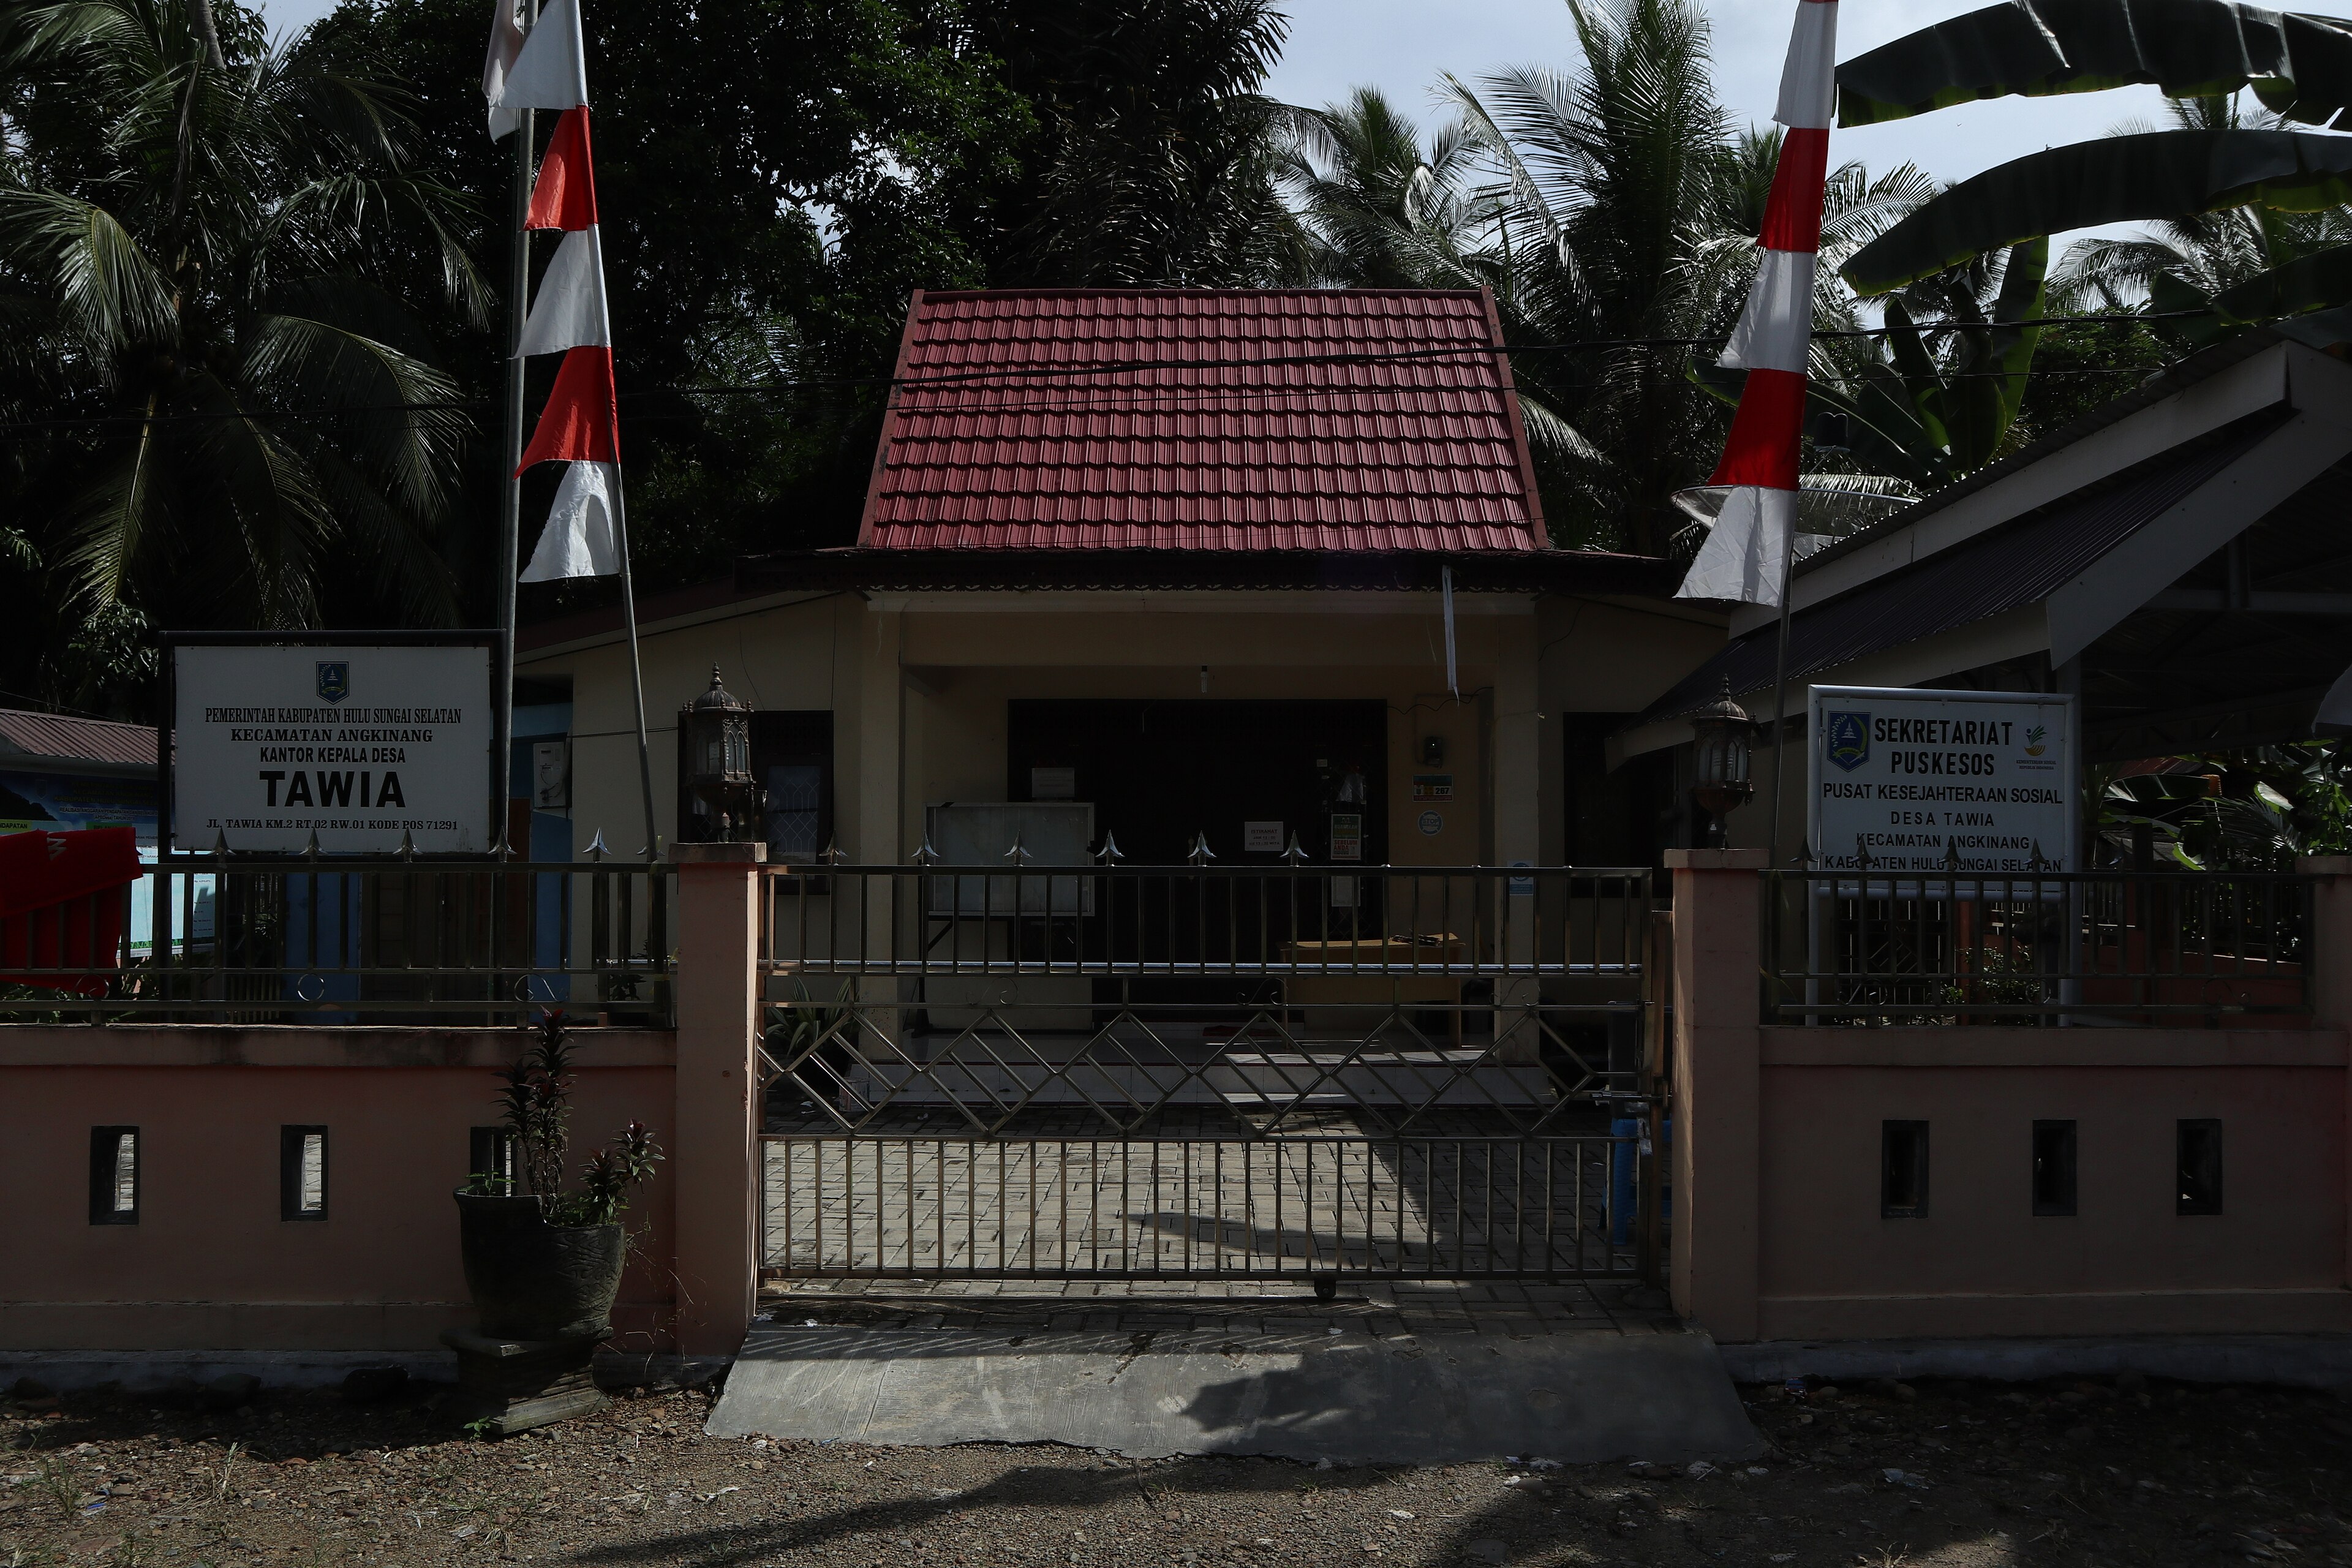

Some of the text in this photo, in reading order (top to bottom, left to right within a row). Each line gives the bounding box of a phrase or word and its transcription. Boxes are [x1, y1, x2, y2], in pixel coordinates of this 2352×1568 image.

[205, 707, 461, 724] PEMERINTAH KABUPATEN HULU SUNGAI SELATAN
[230, 729, 433, 742] KECAMATAN ANGKINANG
[1874, 718, 2013, 746] SEKRETARIAT
[260, 747, 405, 763] KANTOR KEPALA DESA
[1891, 751, 1995, 776] PUSKESOS
[259, 771, 405, 808] TAWIA
[1823, 783, 2063, 804] PUSAT KESEJAHTERAAN SOSIAL
[206, 819, 458, 830] JL. TAWIA KM.2 RT.02 RW.01 KODE POS 71291
[1891, 811, 1995, 826] DESA TAWIA
[1856, 833, 2029, 849] KECAMATAN ANGKINANG
[1825, 856, 1906, 870] KABATEN
[1912, 857, 1945, 870] HULU
[2001, 859, 2061, 872] SELAAN
